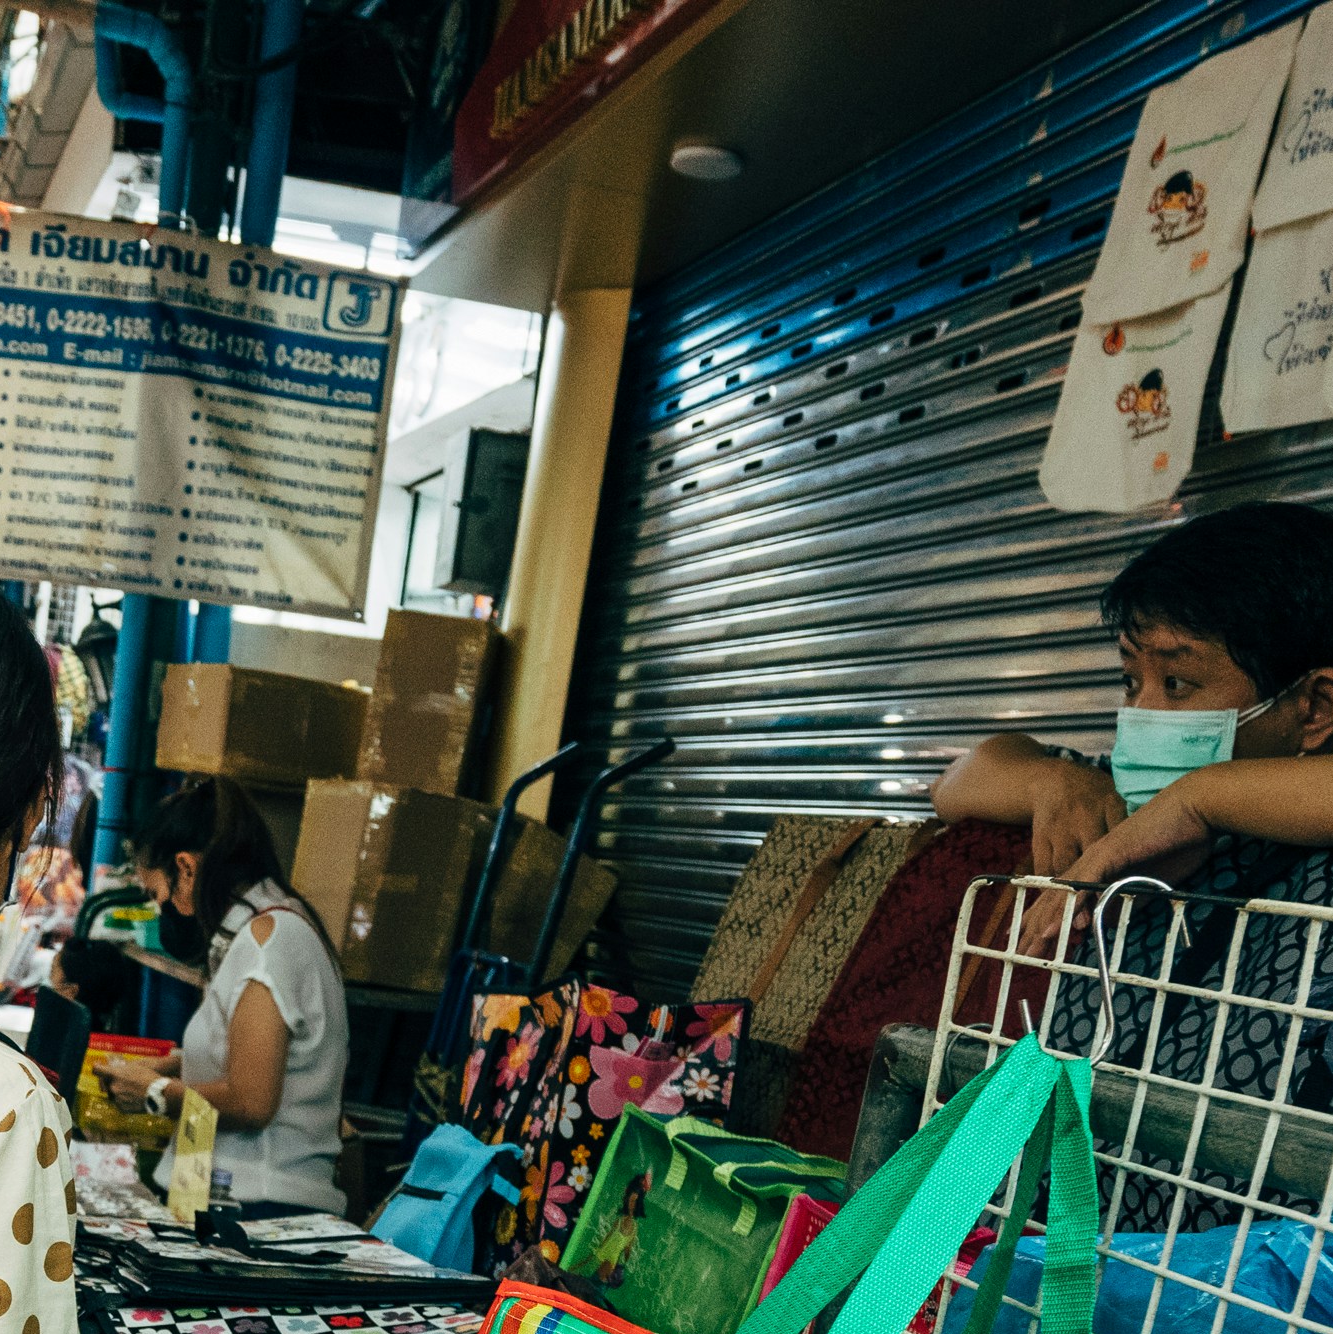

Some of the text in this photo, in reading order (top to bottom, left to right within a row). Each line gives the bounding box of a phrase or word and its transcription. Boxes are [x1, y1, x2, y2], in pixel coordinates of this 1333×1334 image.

[29, 223, 210, 279] เจียมสมาน
[229, 251, 317, 301] จำกัด
[63, 341, 124, 365] E-mail
